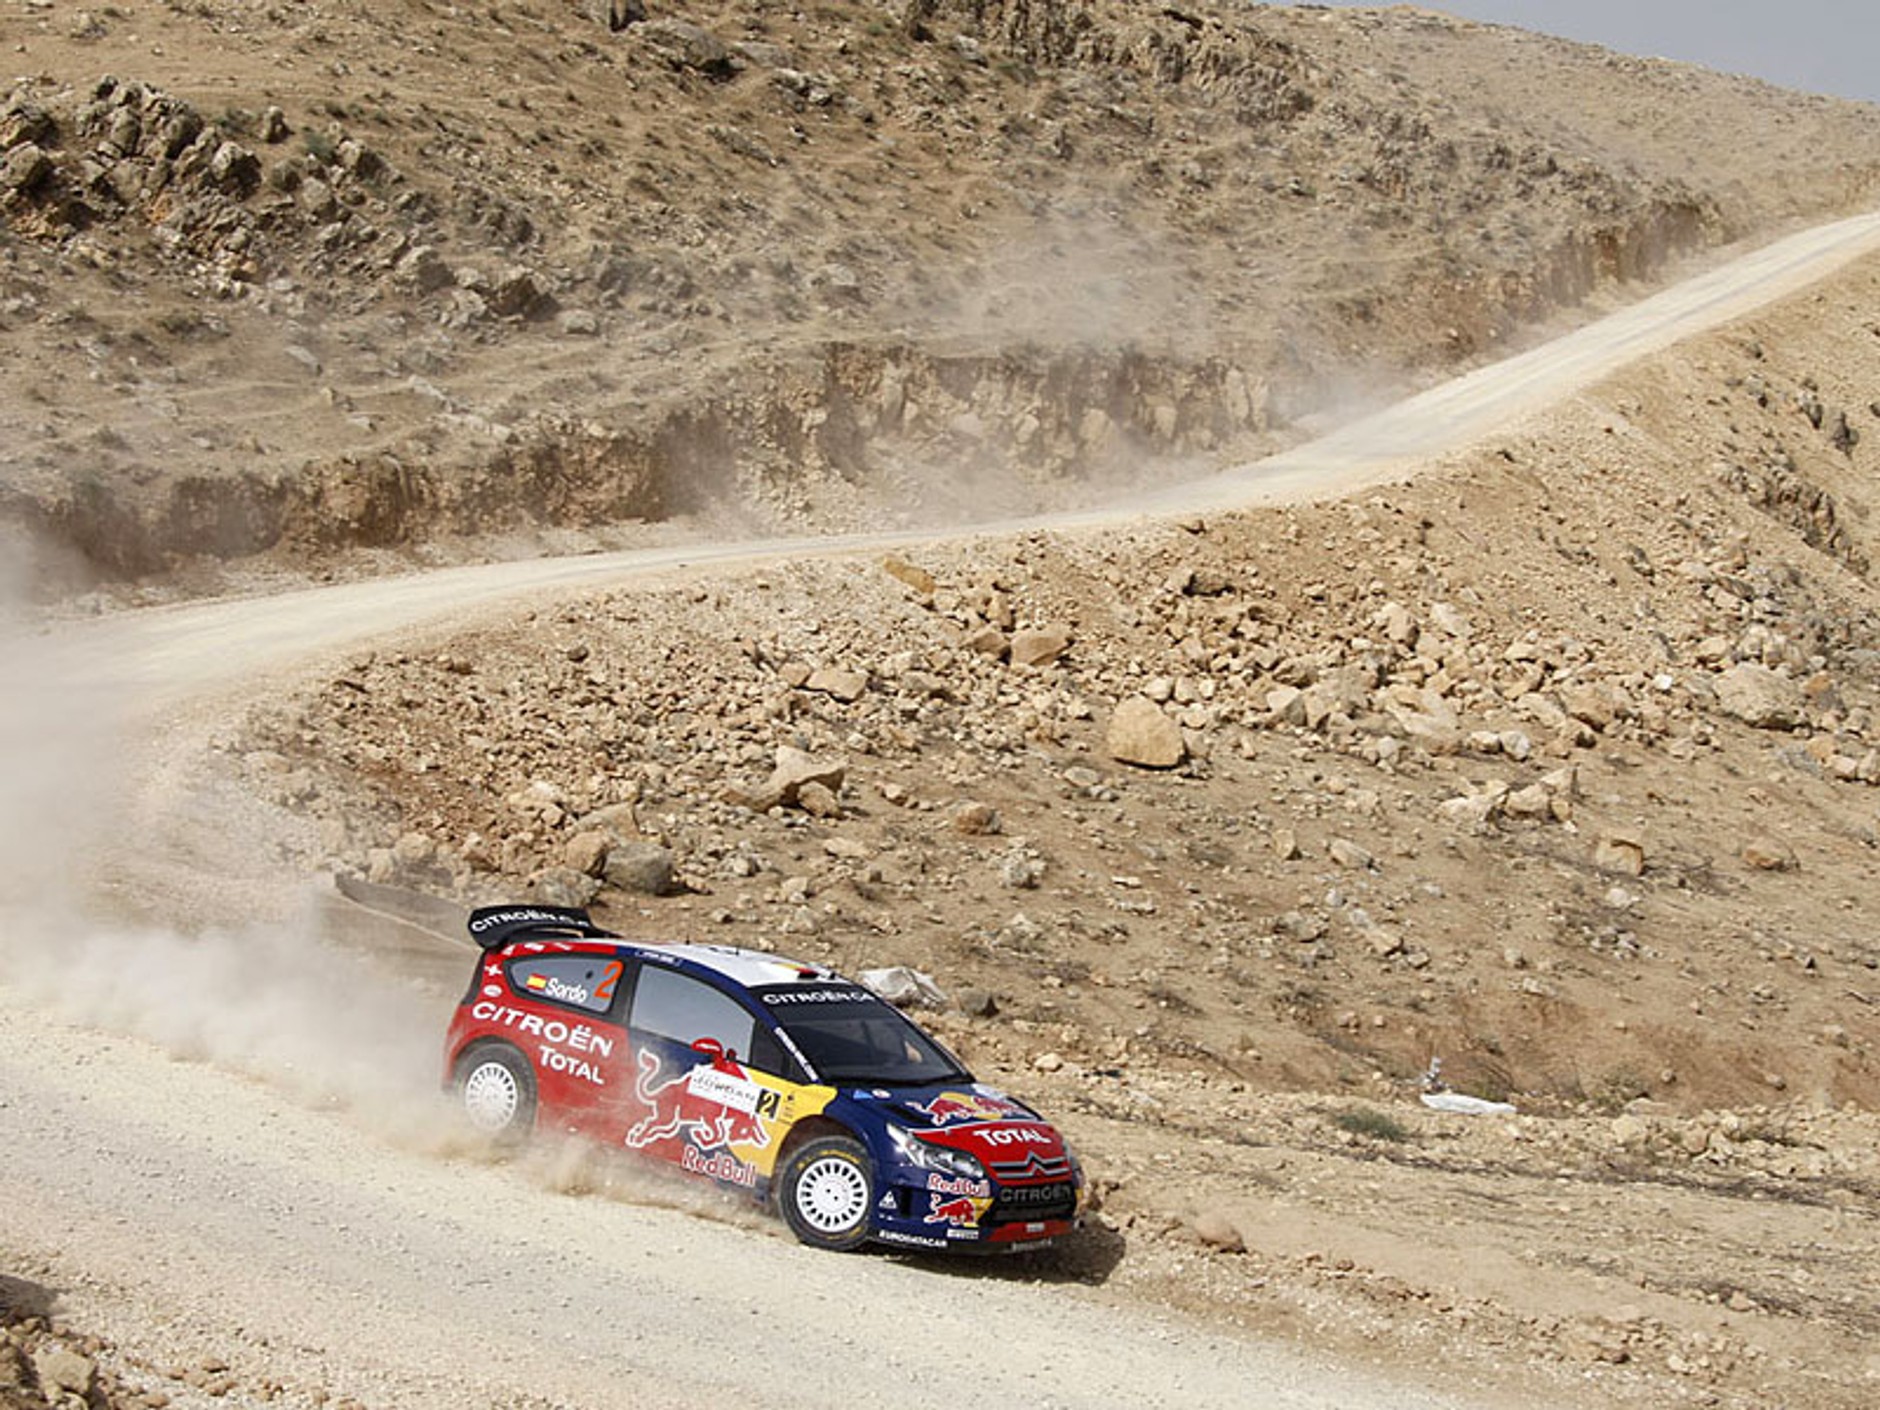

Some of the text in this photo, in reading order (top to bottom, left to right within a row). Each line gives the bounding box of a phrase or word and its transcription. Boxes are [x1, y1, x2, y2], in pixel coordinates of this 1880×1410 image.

[545, 977, 588, 1003] Sordo
[594, 961, 625, 998] 2
[472, 1002, 613, 1057] CITROËN
[539, 1045, 604, 1085] TOTAL
[759, 1091, 775, 1117] 2
[972, 1128, 1052, 1146] TOTAL
[681, 1145, 721, 1175] Red
[719, 1154, 757, 1188] Bull
[927, 1172, 961, 1195] Red
